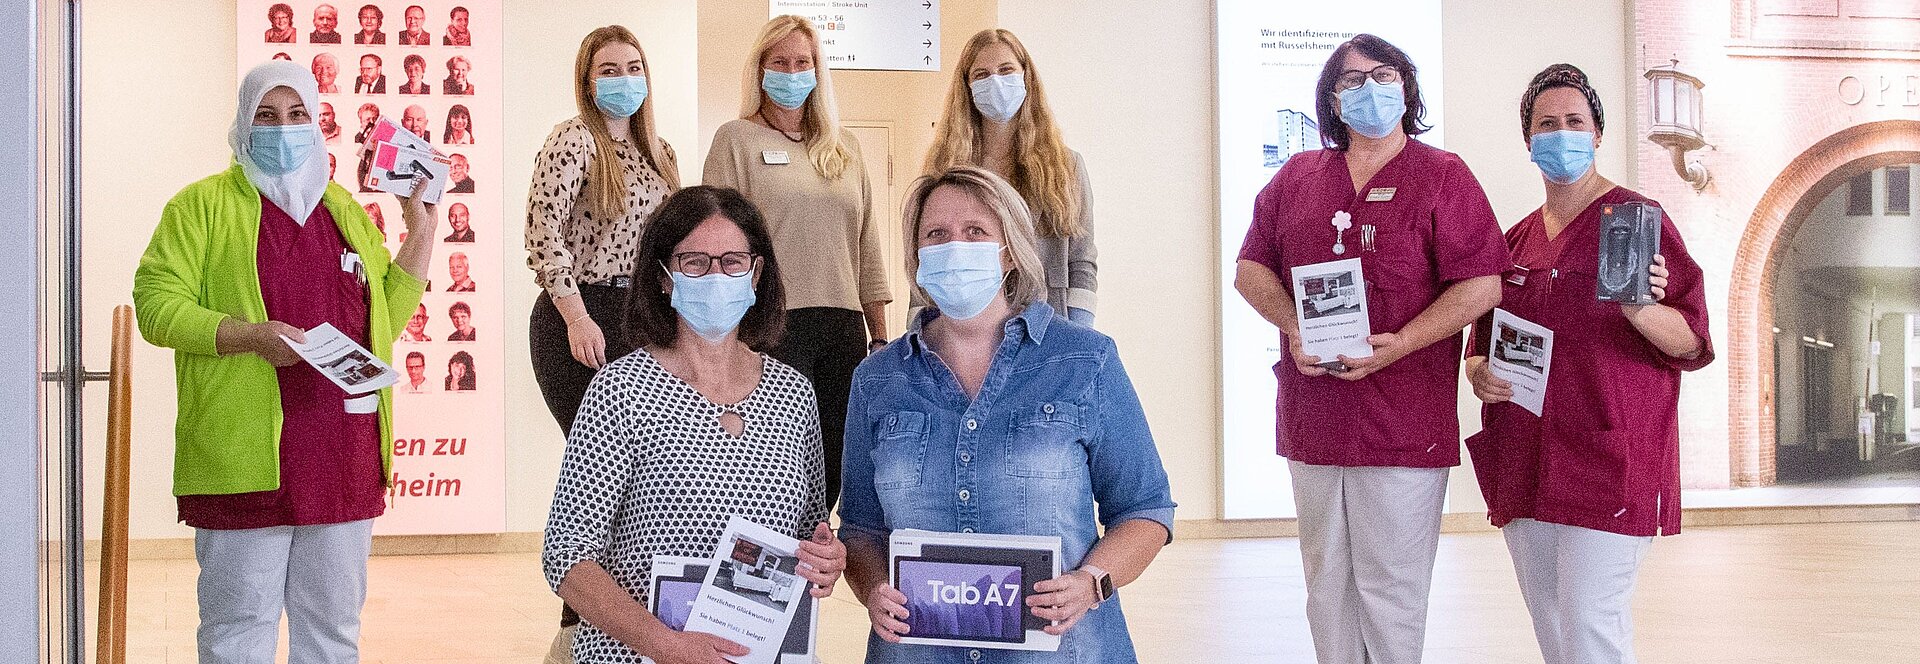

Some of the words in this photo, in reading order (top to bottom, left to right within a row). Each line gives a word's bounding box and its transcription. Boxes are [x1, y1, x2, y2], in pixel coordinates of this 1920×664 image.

[1260, 28, 1276, 37] Wir
[1278, 28, 1340, 38] identifizieren
[432, 438, 467, 456] zu
[390, 472, 462, 497] heim
[928, 580, 980, 605] Tab
[984, 583, 1020, 607] A7
[706, 594, 736, 610] Herzlichen
[736, 605, 775, 625] Glückwunsch!
[698, 612, 709, 620] Sie
[708, 615, 727, 628] haben
[745, 629, 767, 642] belegt!
